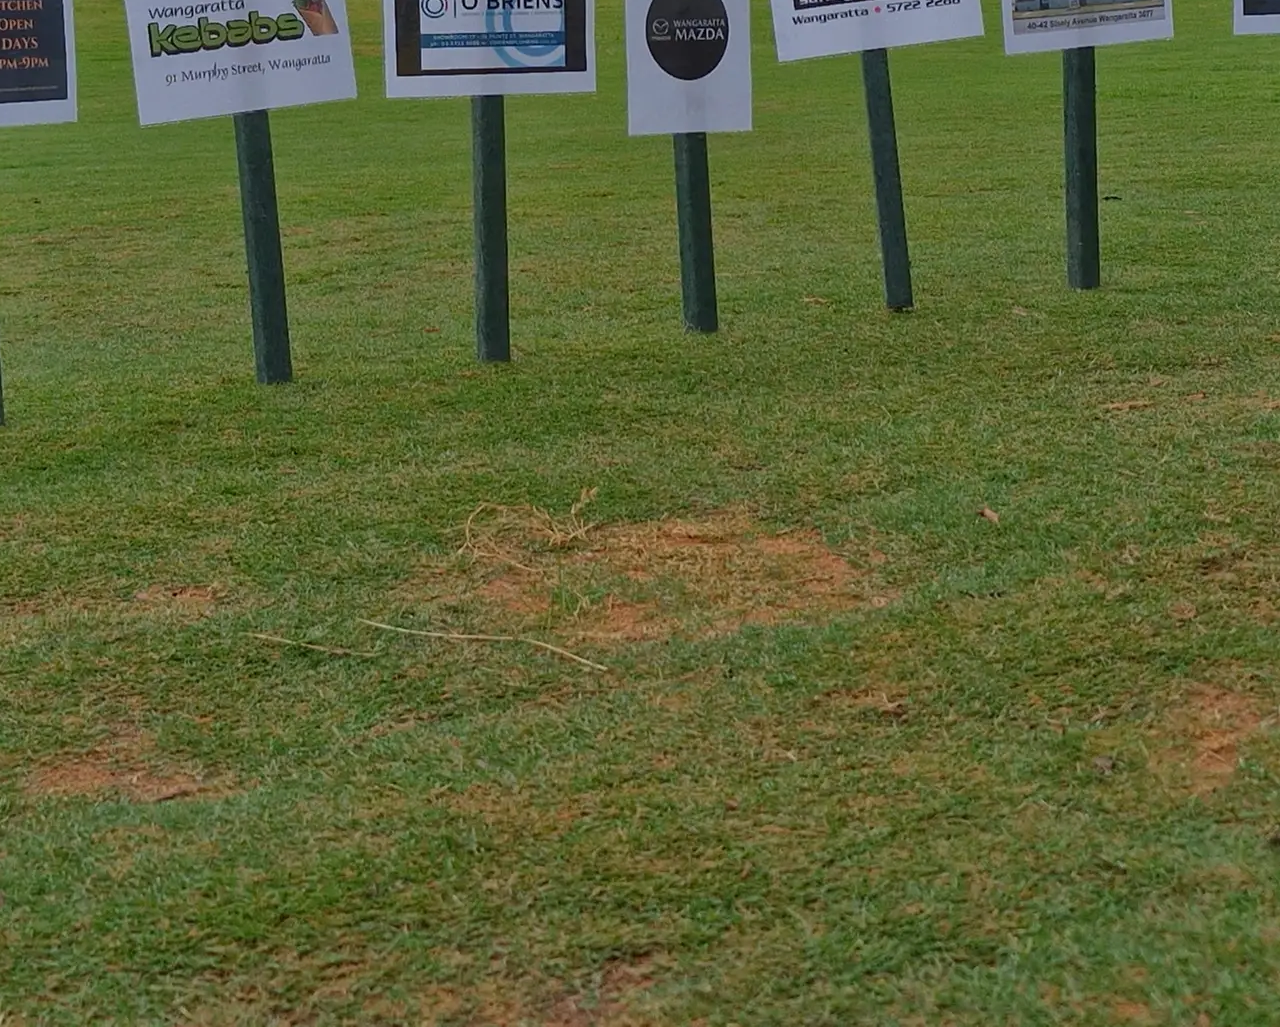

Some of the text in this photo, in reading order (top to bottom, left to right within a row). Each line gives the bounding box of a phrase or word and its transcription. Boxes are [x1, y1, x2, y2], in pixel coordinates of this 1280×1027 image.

[148, 0, 246, 20] Wangaratta
[792, 8, 869, 26] Wangaratta
[886, 0, 921, 13] 5722
[673, 18, 725, 27] WANGARATTA
[1071, 17, 1097, 26] Avenue
[675, 28, 725, 41] MAZDA
[2, 37, 39, 50] DAYS
[166, 54, 331, 86] 91 Murphy Street, Wangaratta
